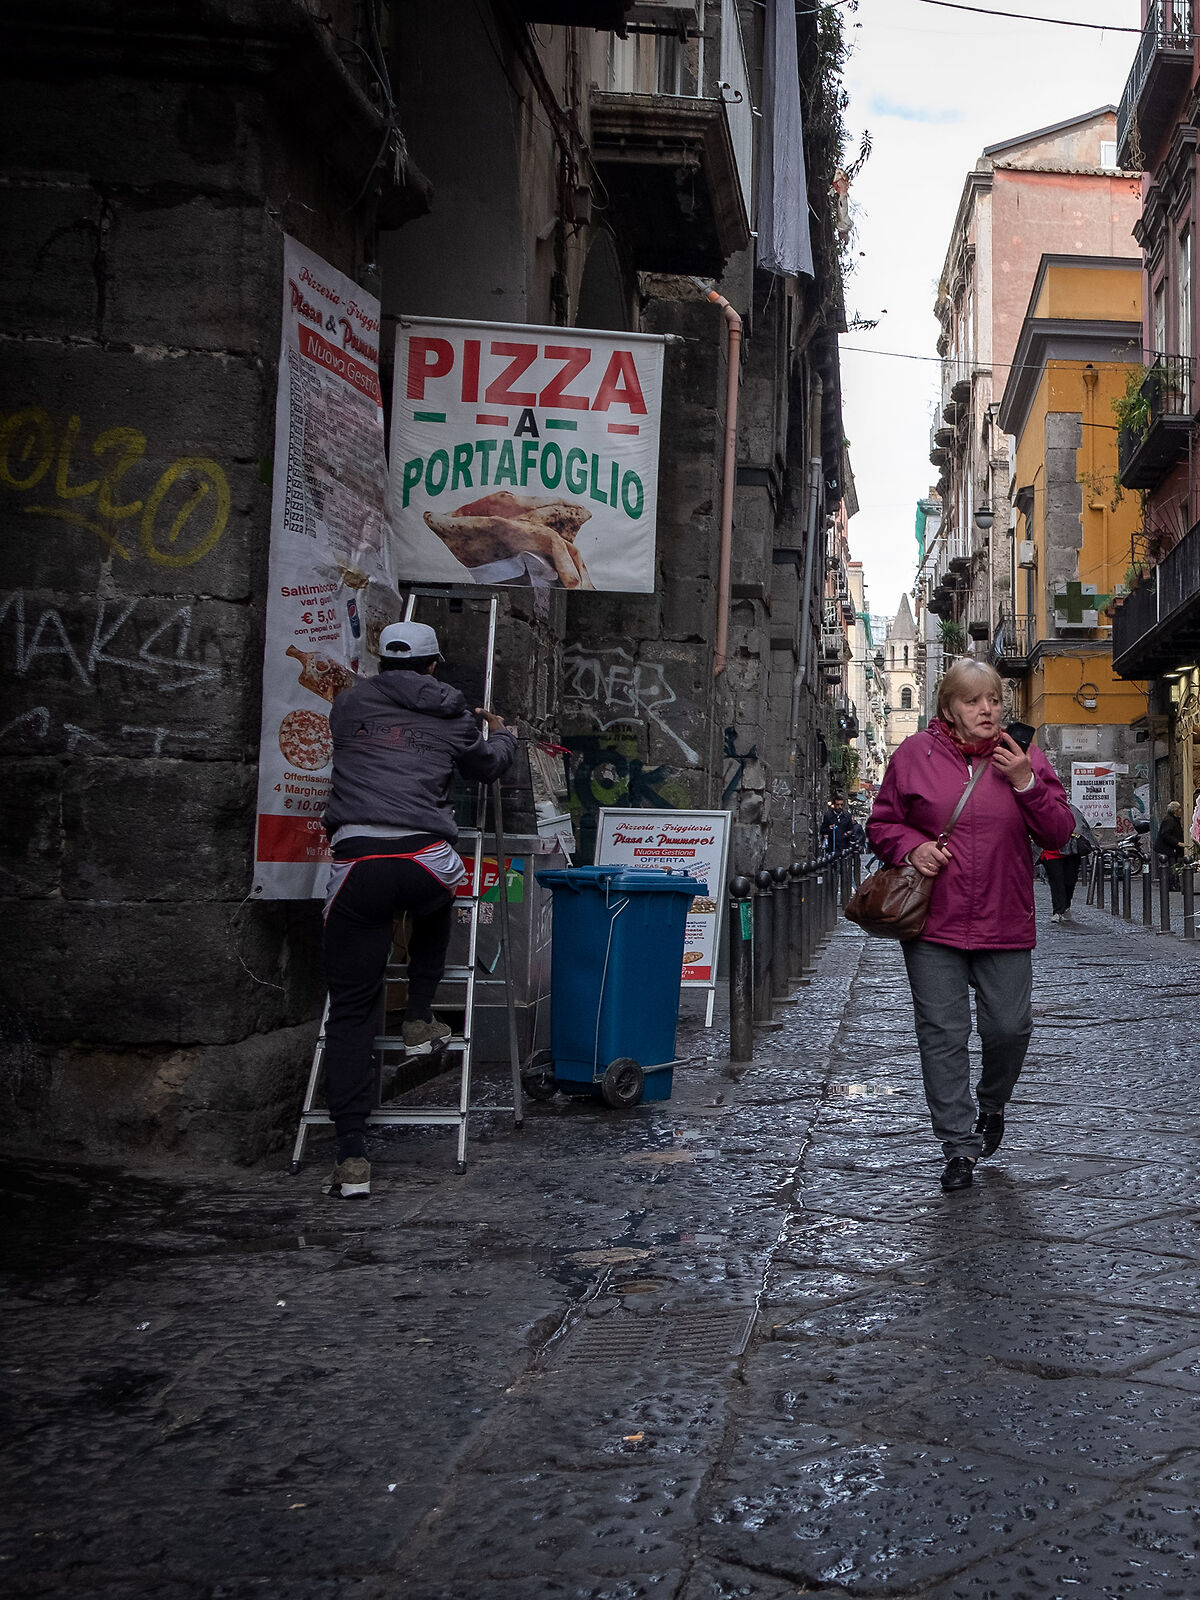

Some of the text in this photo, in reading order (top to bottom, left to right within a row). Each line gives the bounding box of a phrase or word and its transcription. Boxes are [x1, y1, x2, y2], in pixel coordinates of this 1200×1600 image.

[299, 266, 340, 305] Pizzeria
[307, 335, 345, 374] Nuova
[406, 336, 648, 415] PIZZA
[513, 408, 540, 438] A
[402, 439, 645, 520] PORTAFOGLIO
[300, 612, 314, 624] €
[274, 783, 281, 792] 4
[284, 798, 293, 809] €
[616, 823, 655, 831] Pizzeria
[661, 823, 712, 833] Friggitoria
[645, 835, 654, 844] &
[636, 848, 660, 856] Nuova
